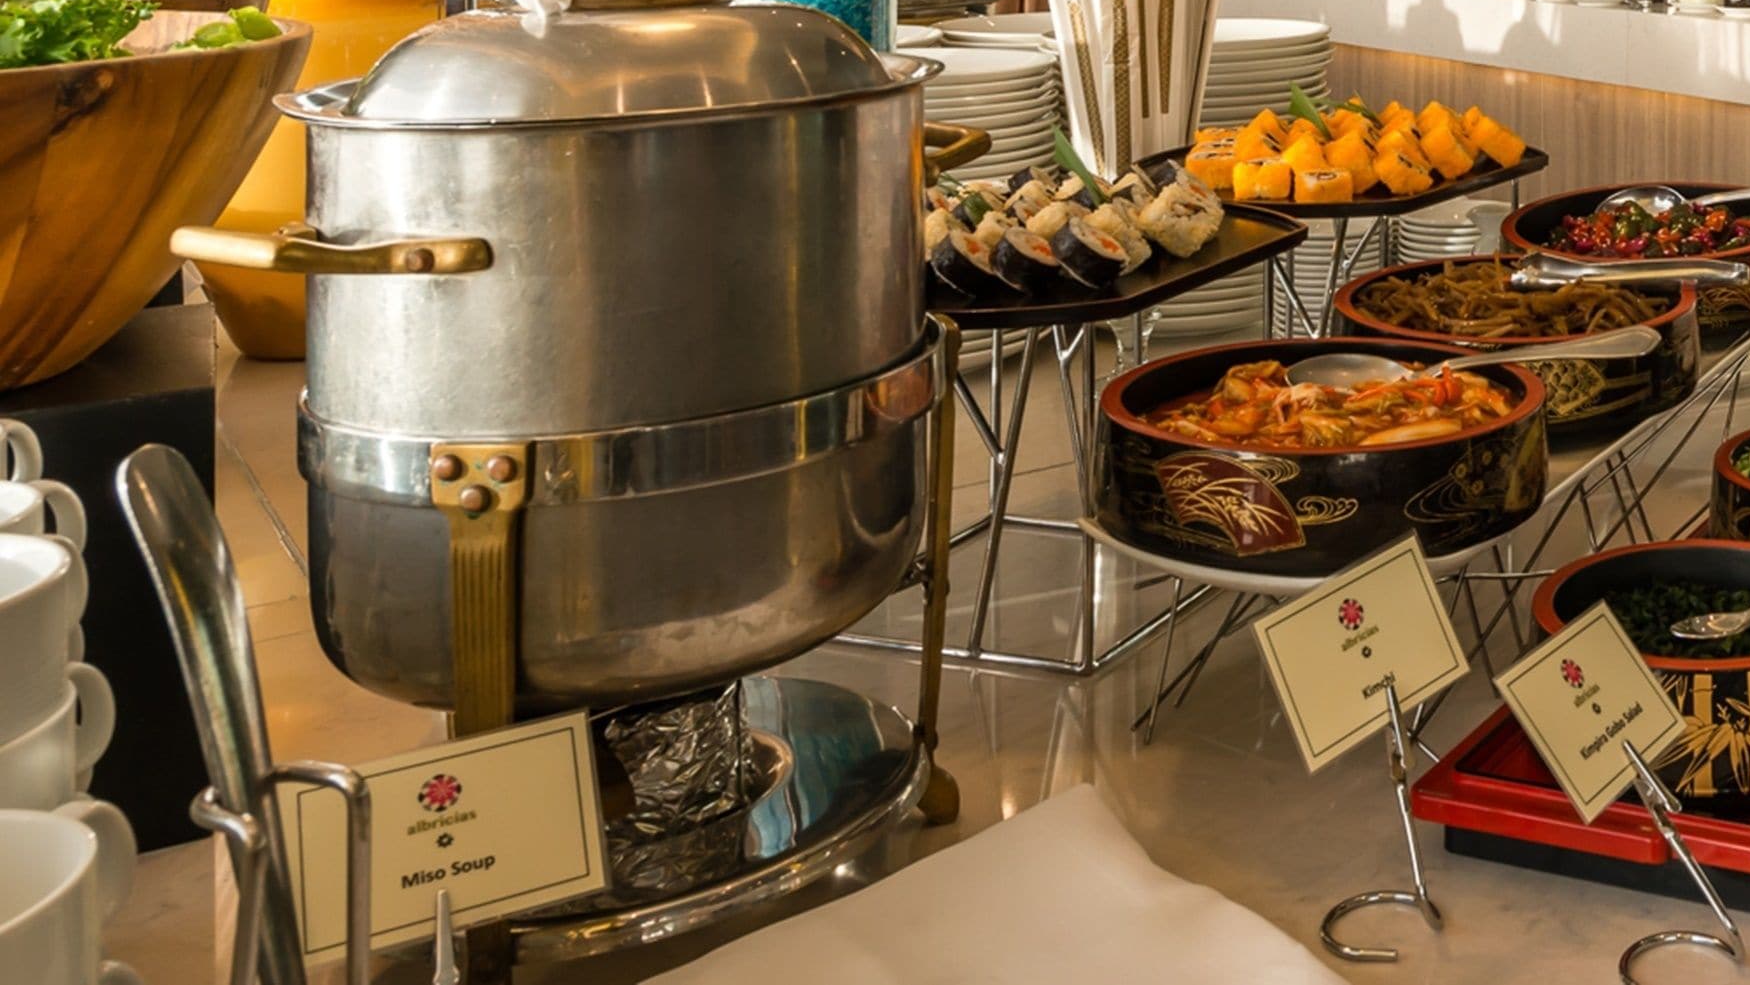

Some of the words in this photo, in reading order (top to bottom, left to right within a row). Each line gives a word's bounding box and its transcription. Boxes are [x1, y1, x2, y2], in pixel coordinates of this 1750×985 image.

[407, 810, 476, 836] albricias
[401, 868, 446, 889] Miso
[450, 855, 496, 876] Soup
